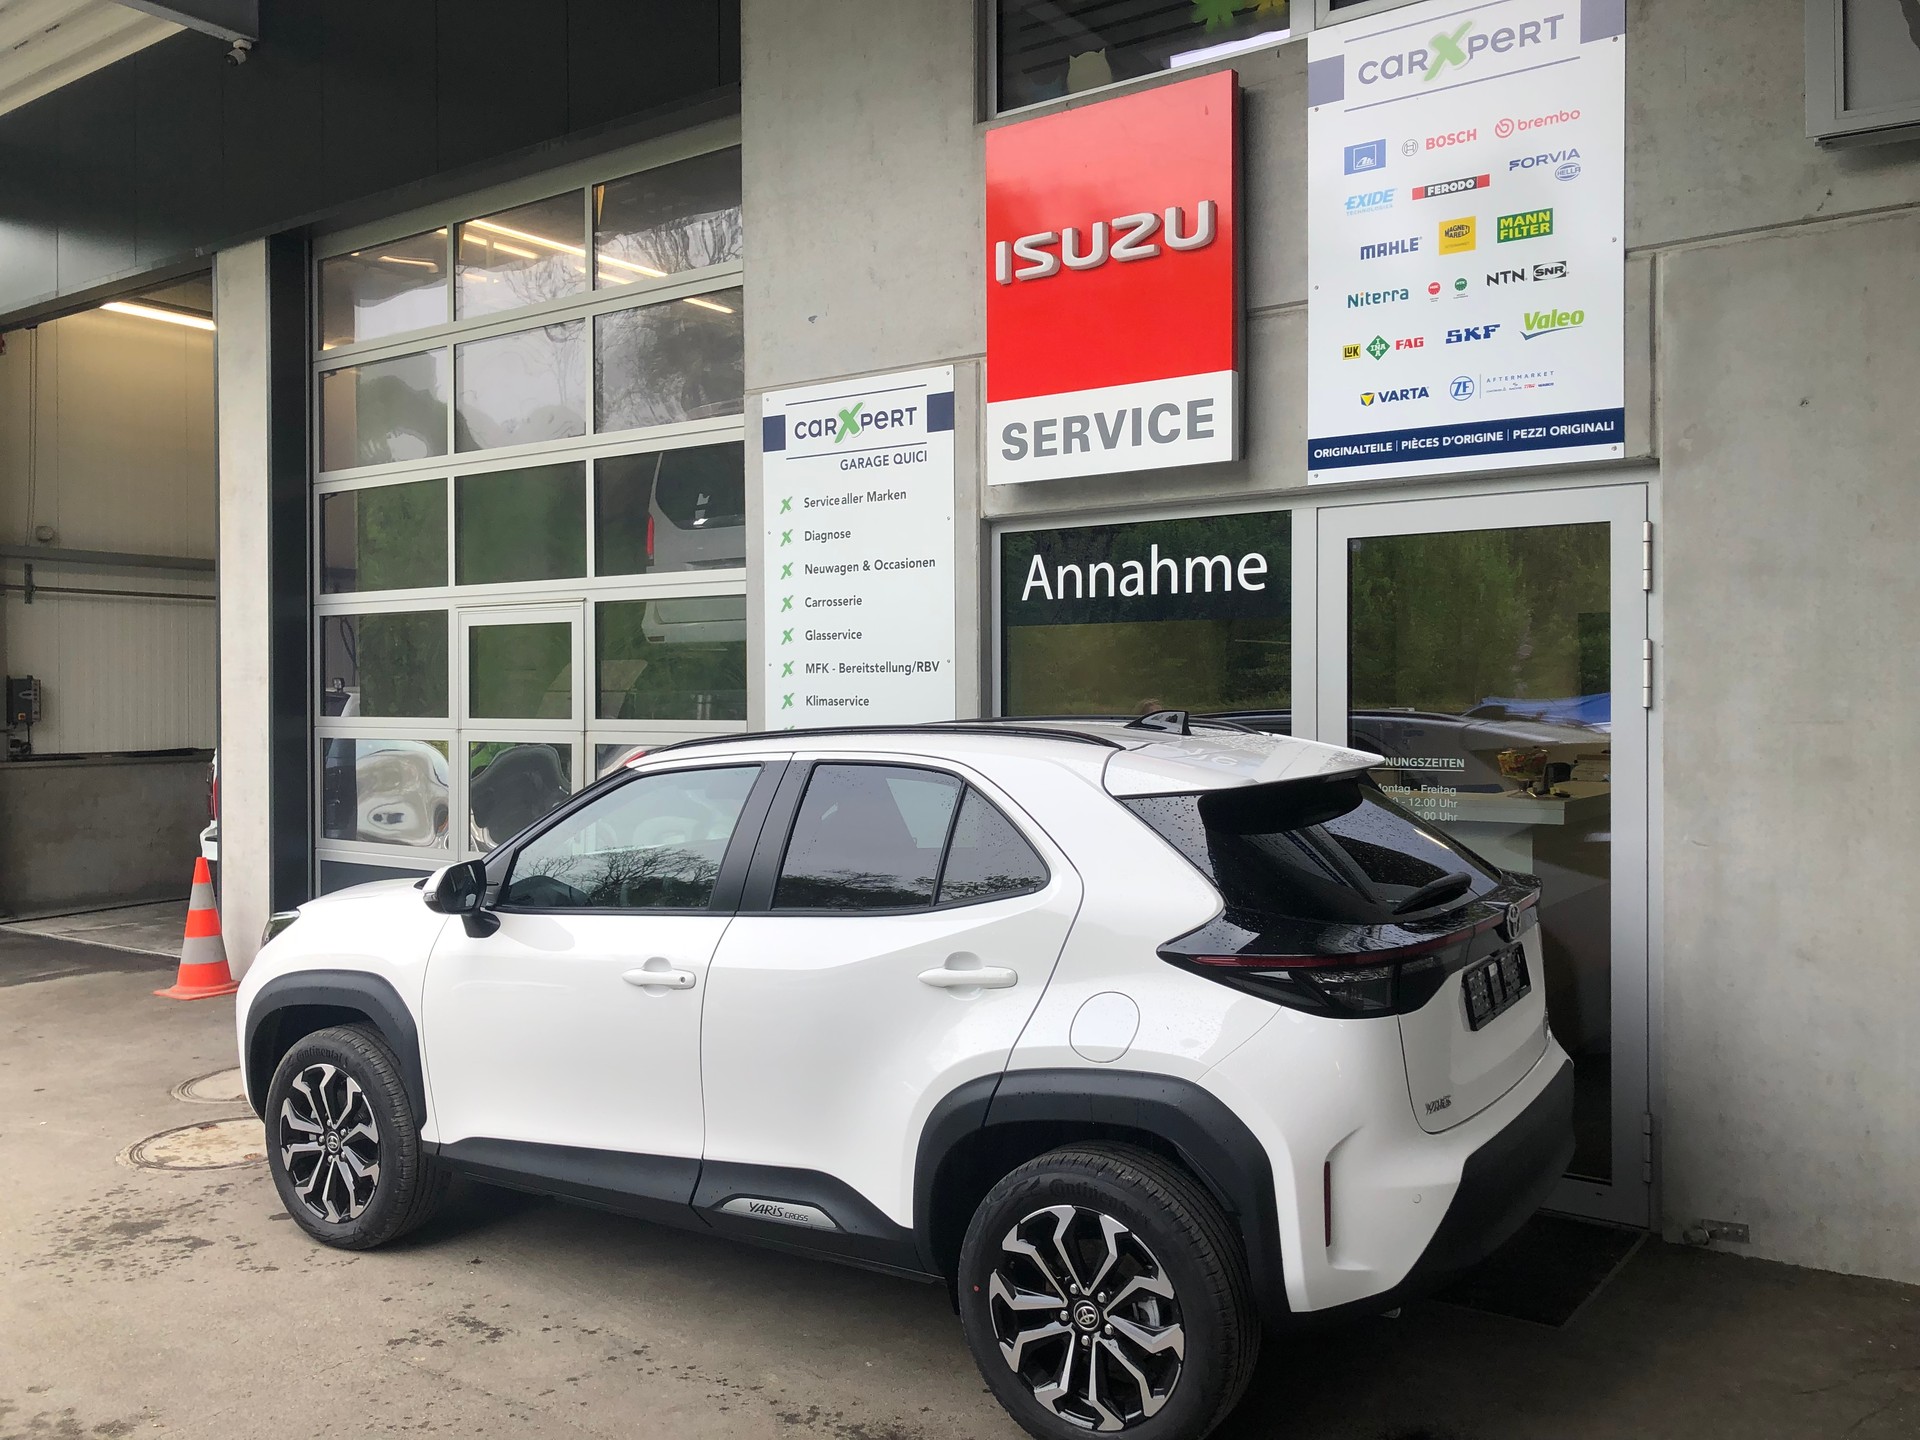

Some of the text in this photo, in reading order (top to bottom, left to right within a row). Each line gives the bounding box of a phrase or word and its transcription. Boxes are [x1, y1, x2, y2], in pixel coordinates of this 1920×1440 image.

[1518, 110, 1581, 131] brembo
[1426, 129, 1477, 150] BOSCH
[1509, 148, 1580, 171] FORVIA
[1428, 178, 1475, 197] FERODO
[1344, 188, 1397, 210] EXIDE
[1500, 211, 1550, 228] MANN
[1500, 223, 1550, 240] FILTER
[995, 199, 1216, 285] ISUZU
[1360, 237, 1419, 260] MAHLE
[1486, 265, 1565, 286] NTN SNR
[1347, 288, 1409, 308] Niterra
[1524, 309, 1584, 332] Valeo
[1395, 337, 1424, 350] FAG
[1445, 324, 1500, 344] SKF
[1486, 371, 1554, 383] AFTERMARKET
[1378, 386, 1429, 403] VARTA
[1453, 380, 1471, 396] ZF
[1001, 398, 1215, 461] SERVICE
[1313, 441, 1393, 459] ORIGINALTEILE
[1401, 437, 1440, 451] PIÈCES
[1512, 427, 1547, 440] PEZZI
[1549, 420, 1615, 437] ORIGINALI
[840, 450, 928, 471] GARAGE QUICI
[803, 489, 907, 508] Service aller Marken
[804, 529, 852, 543] Diagnose
[804, 557, 936, 576] Neuwagen & Occasionen
[1021, 544, 1268, 602] Annahme
[804, 595, 863, 608] Carrosserie
[804, 628, 863, 641] Glasservice
[805, 663, 830, 674] MFK
[838, 661, 940, 676] Bereitstellung/RBV
[805, 695, 870, 707] Klimaservice
[1385, 757, 1465, 768] NUNGSZEITEN
[1420, 784, 1457, 797] Freitag
[1408, 798, 1436, 808] 12.00
[1439, 799, 1458, 808] Uhr
[1439, 812, 1458, 822] Uhr
